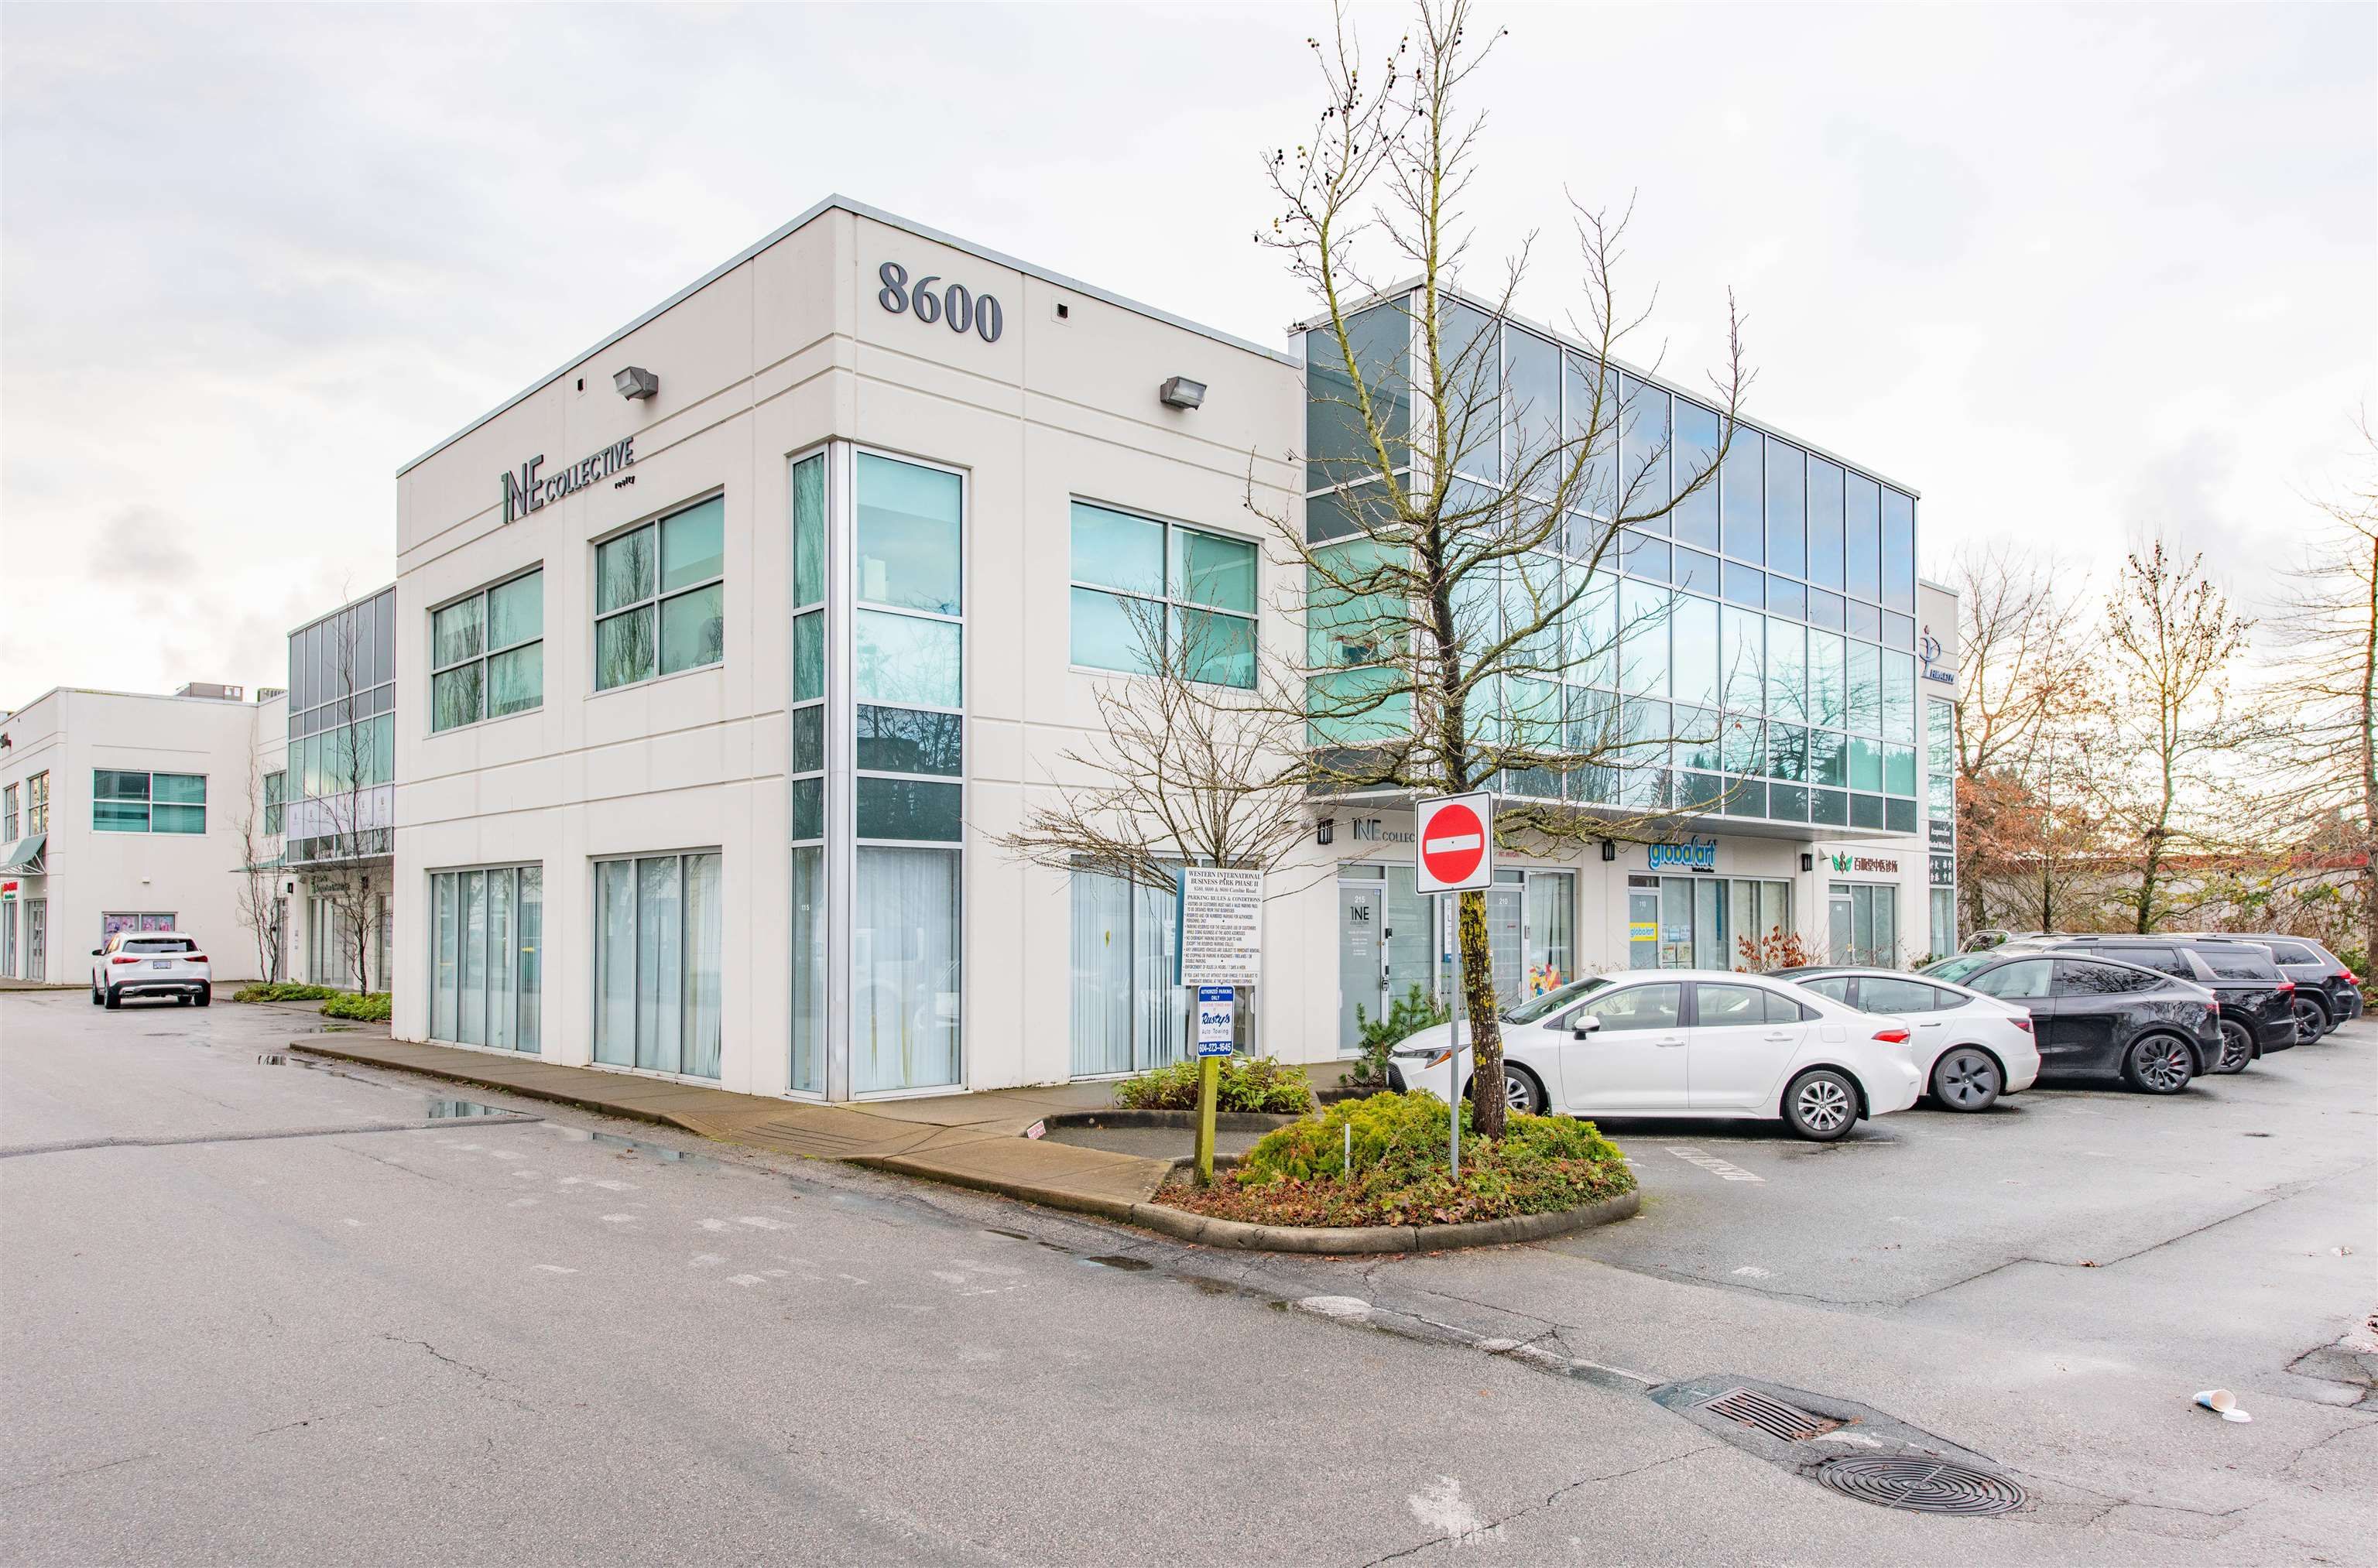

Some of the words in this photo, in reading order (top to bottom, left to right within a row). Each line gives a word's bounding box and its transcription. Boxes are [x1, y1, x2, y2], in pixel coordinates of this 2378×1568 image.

[879, 262, 1003, 343] 8600
[545, 436, 634, 502] COLLECTIVE
[1382, 831, 1415, 843] COLLEC
[1217, 871, 1262, 880] INTERNATIONAL
[1201, 1012, 1230, 1028] Rusty's
[1199, 1042, 1232, 1053] 604-273-1645
